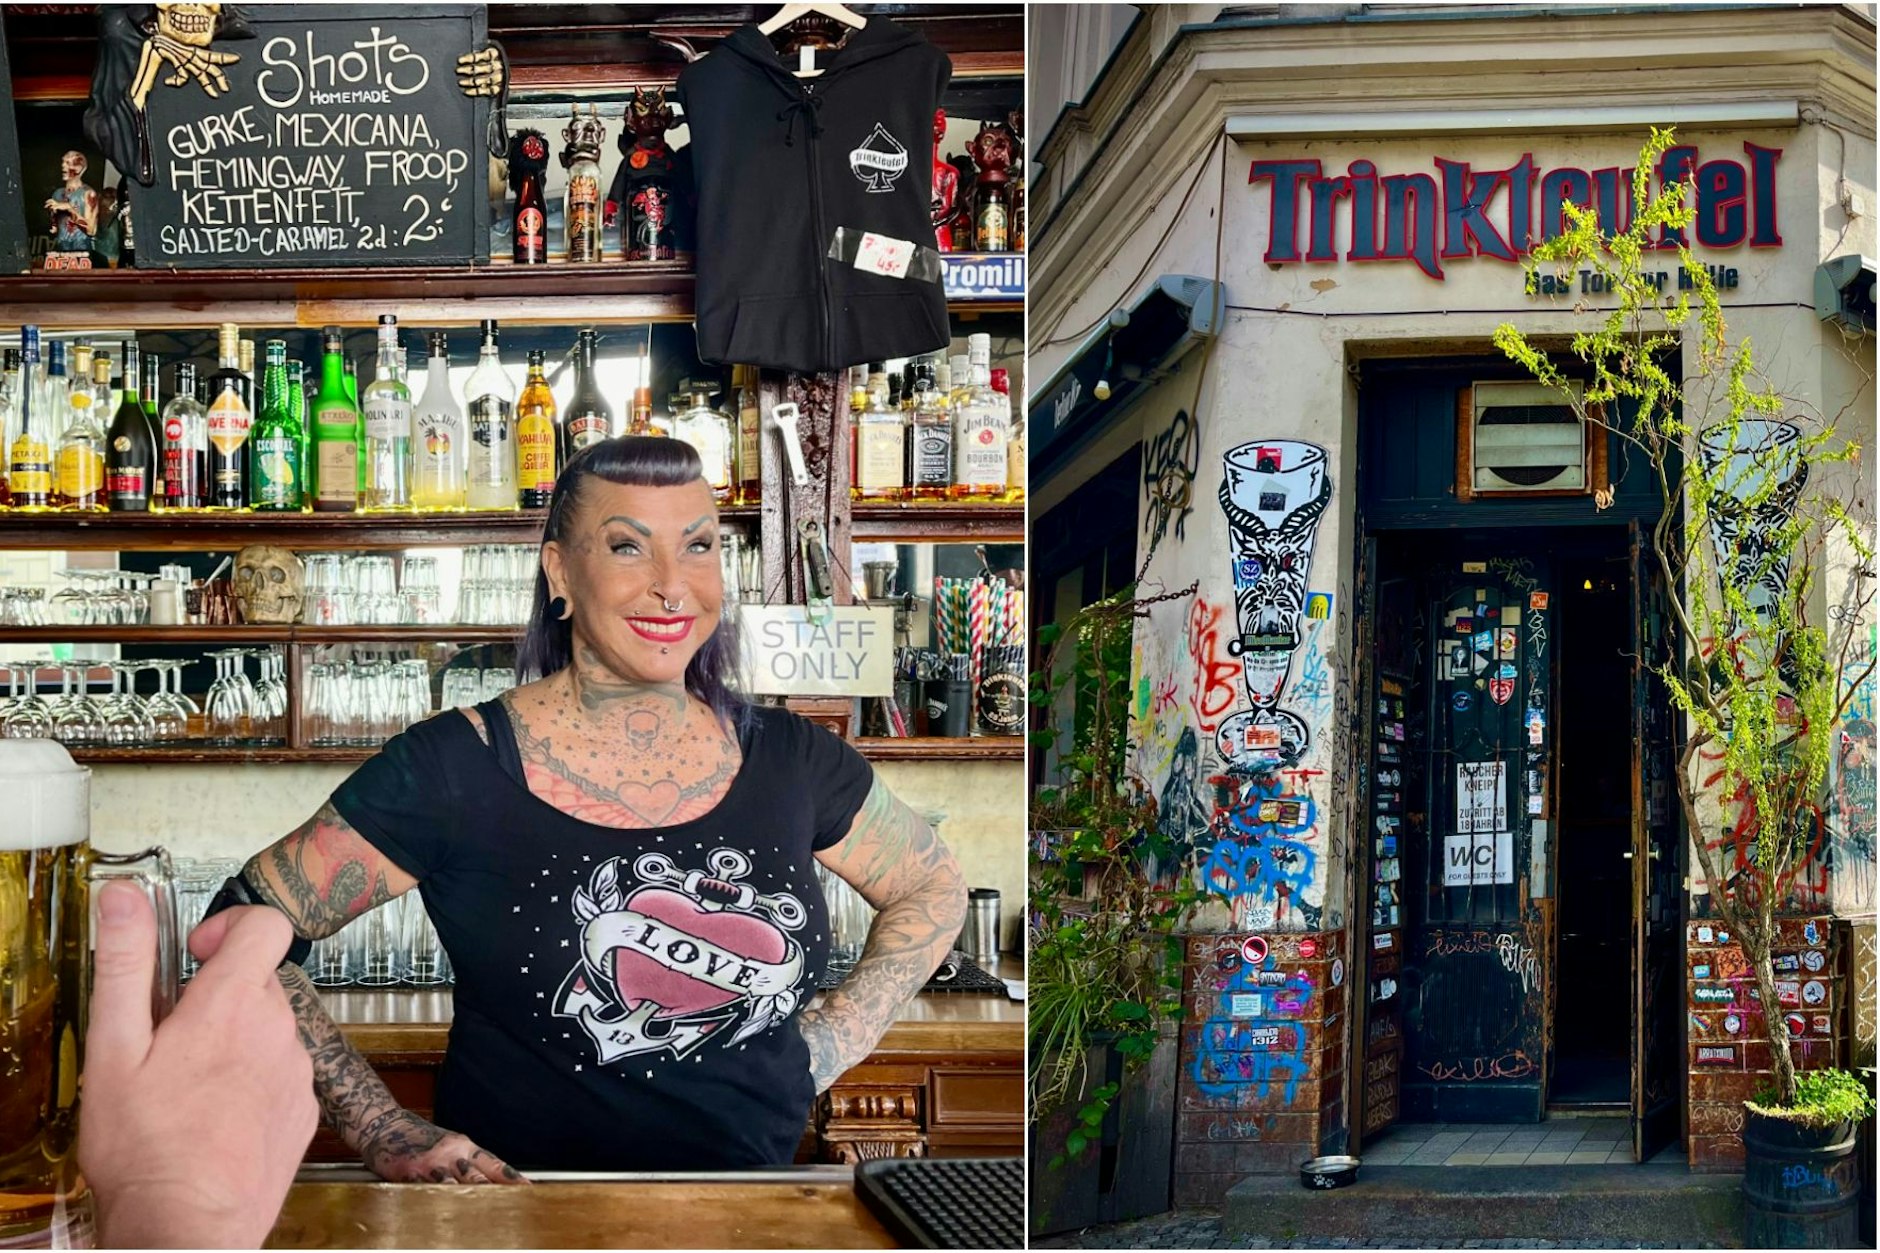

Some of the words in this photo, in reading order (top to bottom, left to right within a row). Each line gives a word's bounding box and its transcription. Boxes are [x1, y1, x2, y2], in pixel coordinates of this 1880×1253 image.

[257, 26, 430, 108] Shots
[309, 89, 391, 105] HOMEMADE
[167, 105, 272, 159] GURKE,
[275, 113, 440, 149] MEXICANA,
[170, 154, 345, 191] HEMINGWAY,
[182, 187, 365, 228] KETTENFETT,
[1248, 141, 1783, 281] Trinkteufel
[160, 225, 349, 256] SALTED-CARAMEL
[966, 453, 1004, 464] BOURBON
[762, 620, 876, 649] STAFF
[771, 652, 868, 680] ONLY
[1450, 845, 1493, 867] WC
[634, 922, 760, 989] LOVE
[608, 1028, 635, 1045] 13
[1252, 1036, 1278, 1045] 1312
